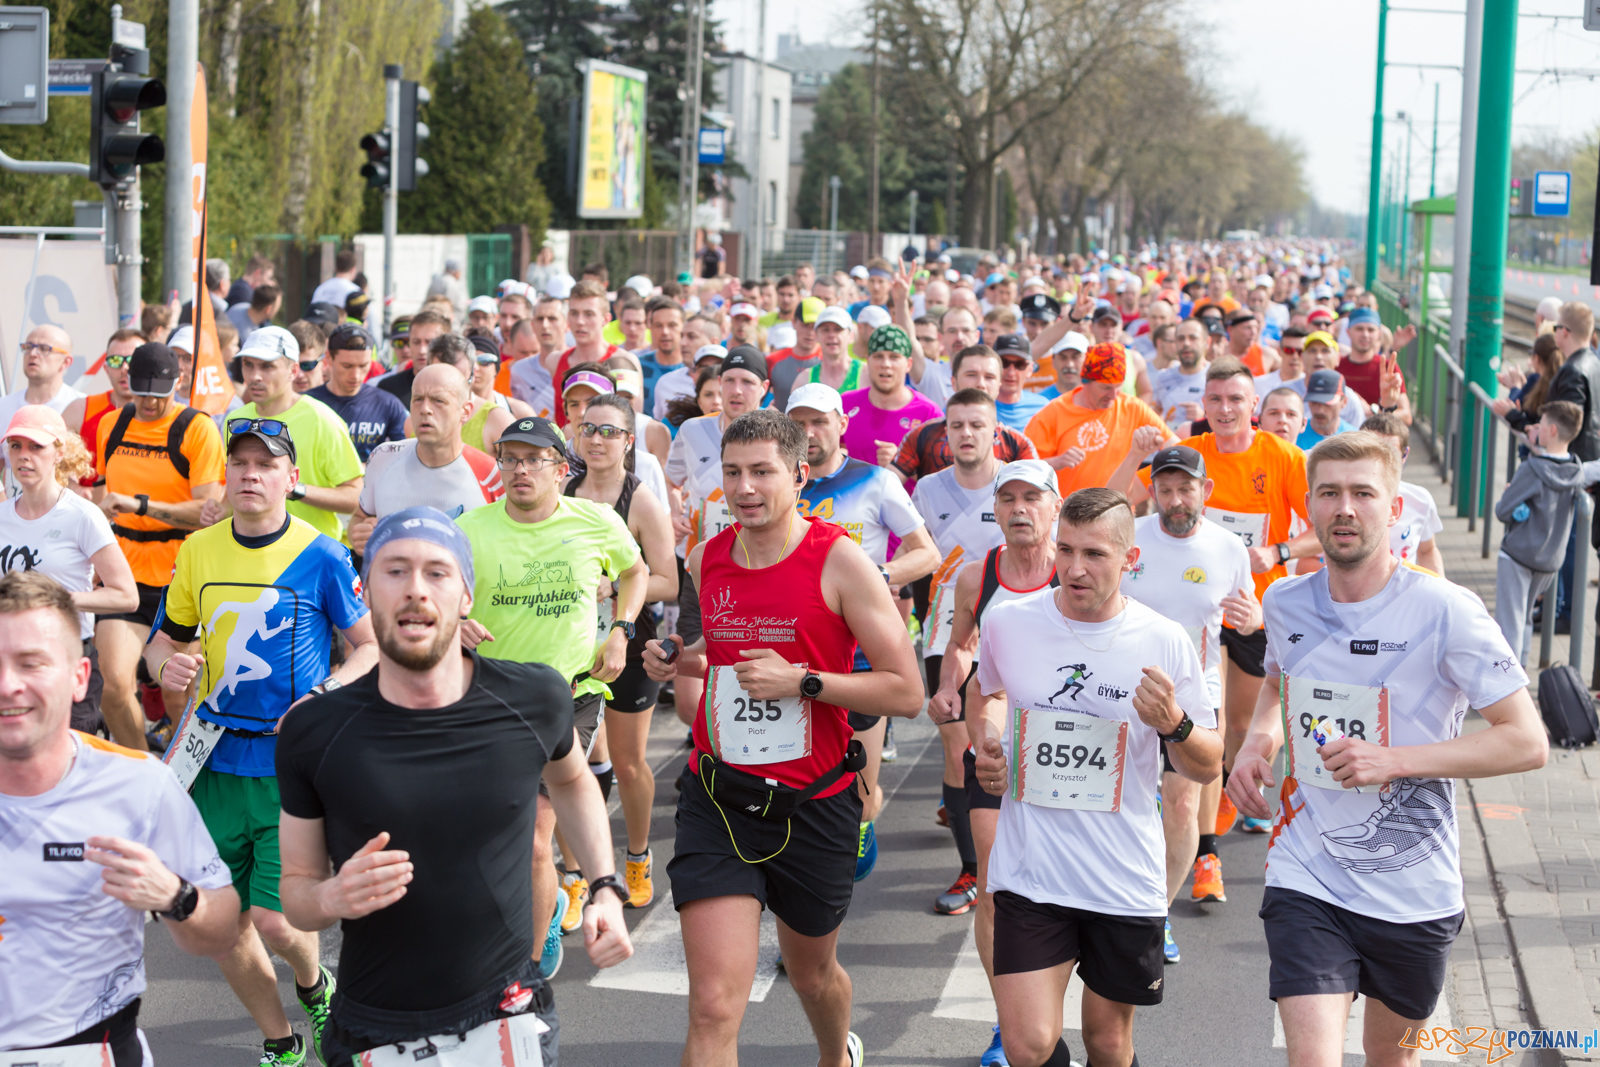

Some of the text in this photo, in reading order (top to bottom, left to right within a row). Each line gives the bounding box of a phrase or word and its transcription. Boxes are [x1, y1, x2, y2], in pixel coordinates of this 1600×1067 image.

[358, 421, 385, 436] RUN
[115, 447, 150, 458] EMAKER
[491, 588, 584, 608] Starzyńskiego
[536, 604, 570, 618] biega
[733, 697, 782, 722] 255
[748, 727, 766, 735] Piotr
[1300, 711, 1366, 742] 918
[1036, 742, 1107, 771] 8594
[1052, 772, 1088, 782] Krzysztof
